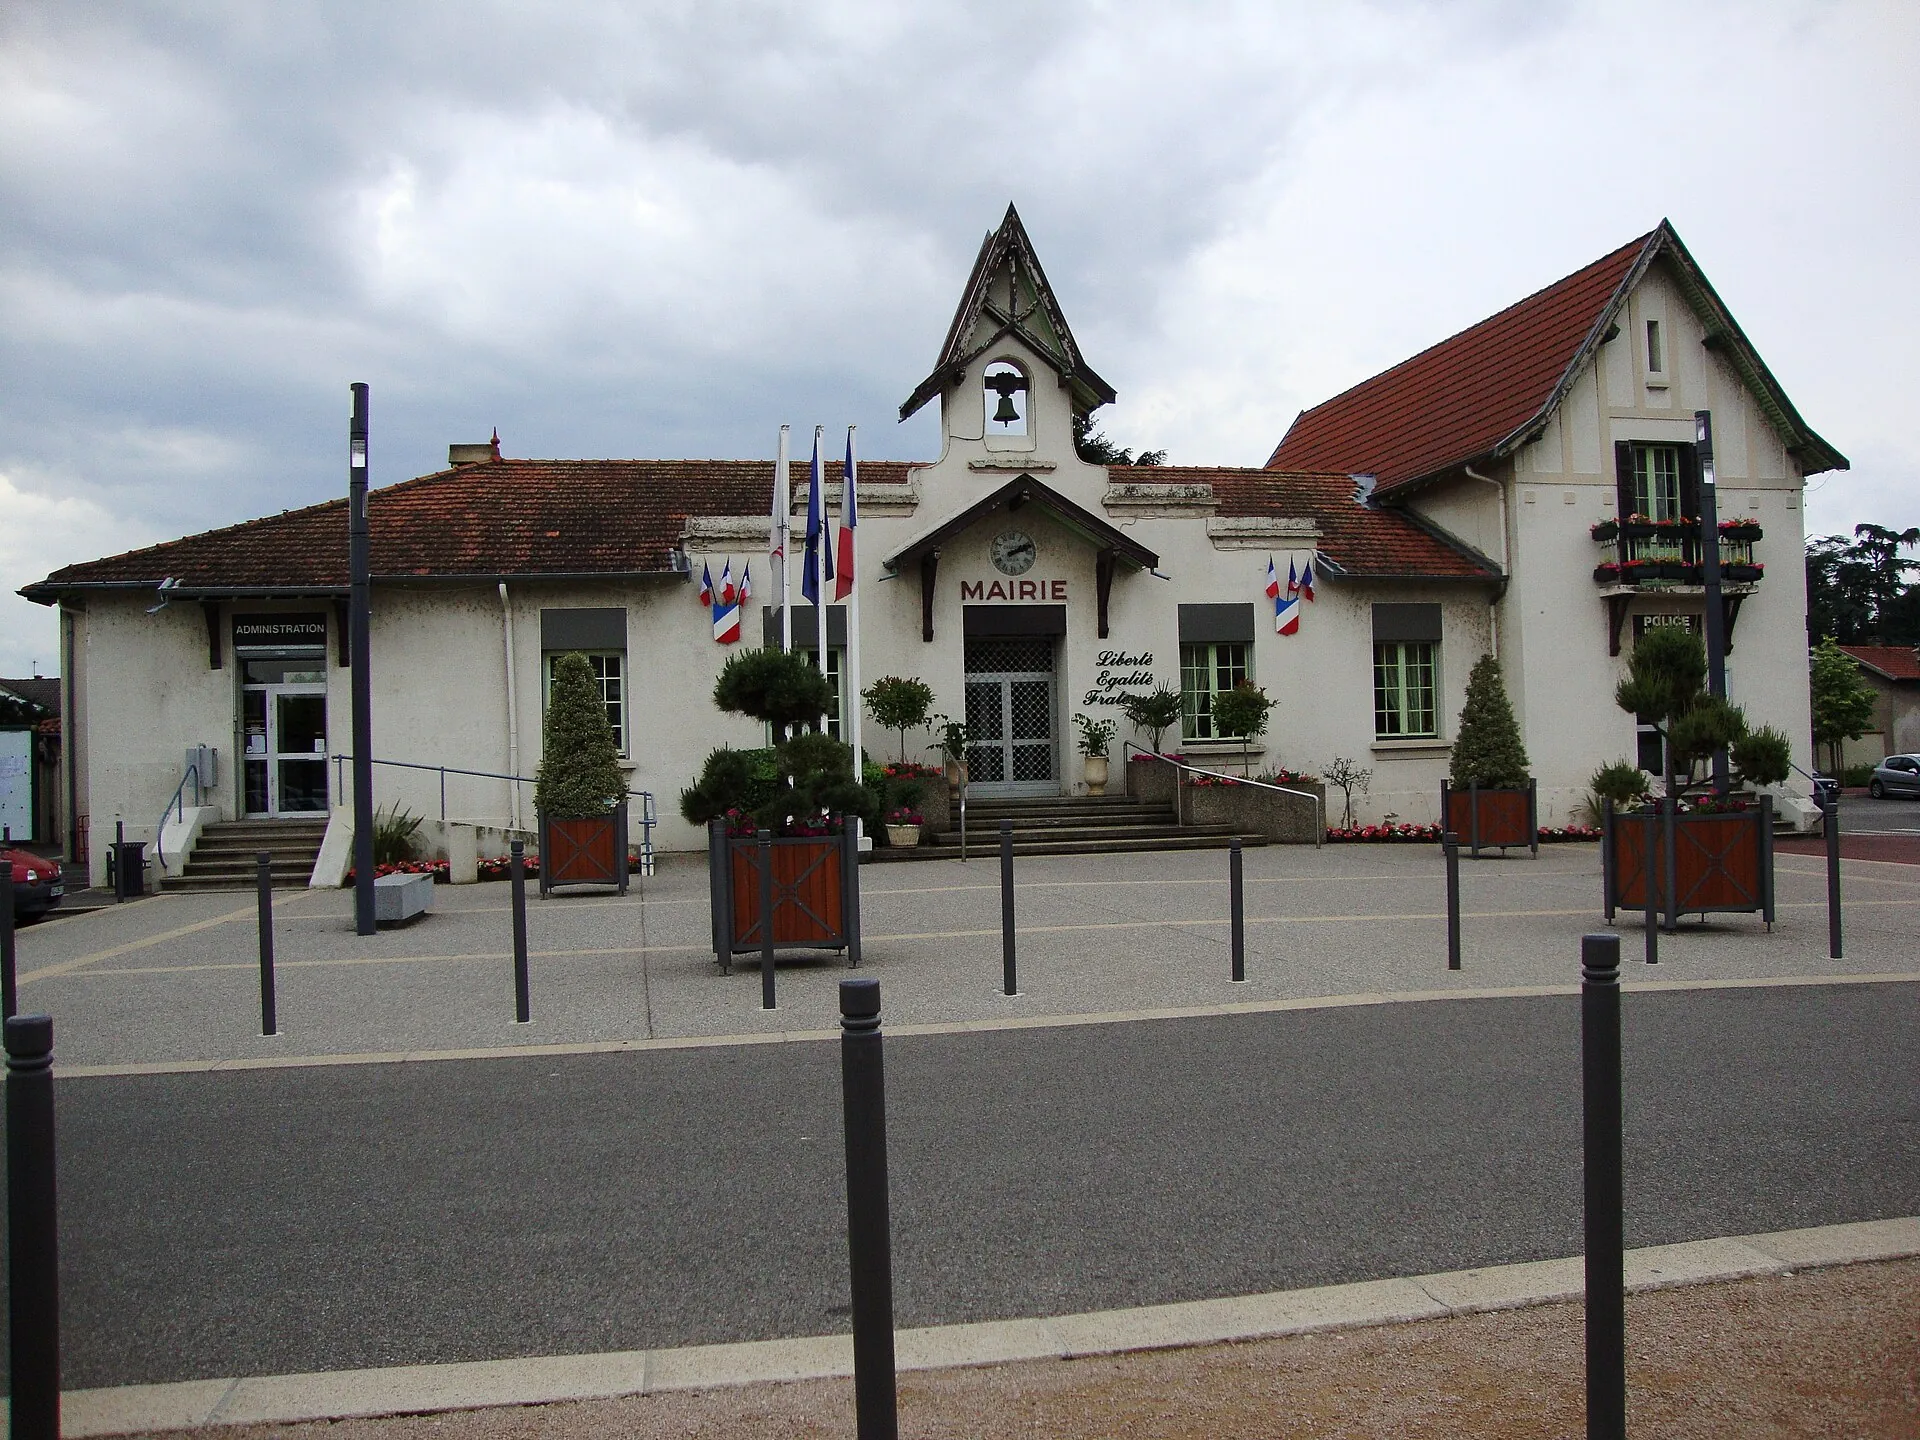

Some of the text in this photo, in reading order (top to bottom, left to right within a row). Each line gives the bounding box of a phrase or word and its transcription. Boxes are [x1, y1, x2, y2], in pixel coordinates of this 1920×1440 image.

[960, 580, 1067, 600] MAIRIE
[236, 624, 325, 634] ADMINISTRATION
[1643, 616, 1690, 627] POLICE
[1095, 650, 1153, 667] Liberté
[1096, 670, 1154, 692] Egalité
